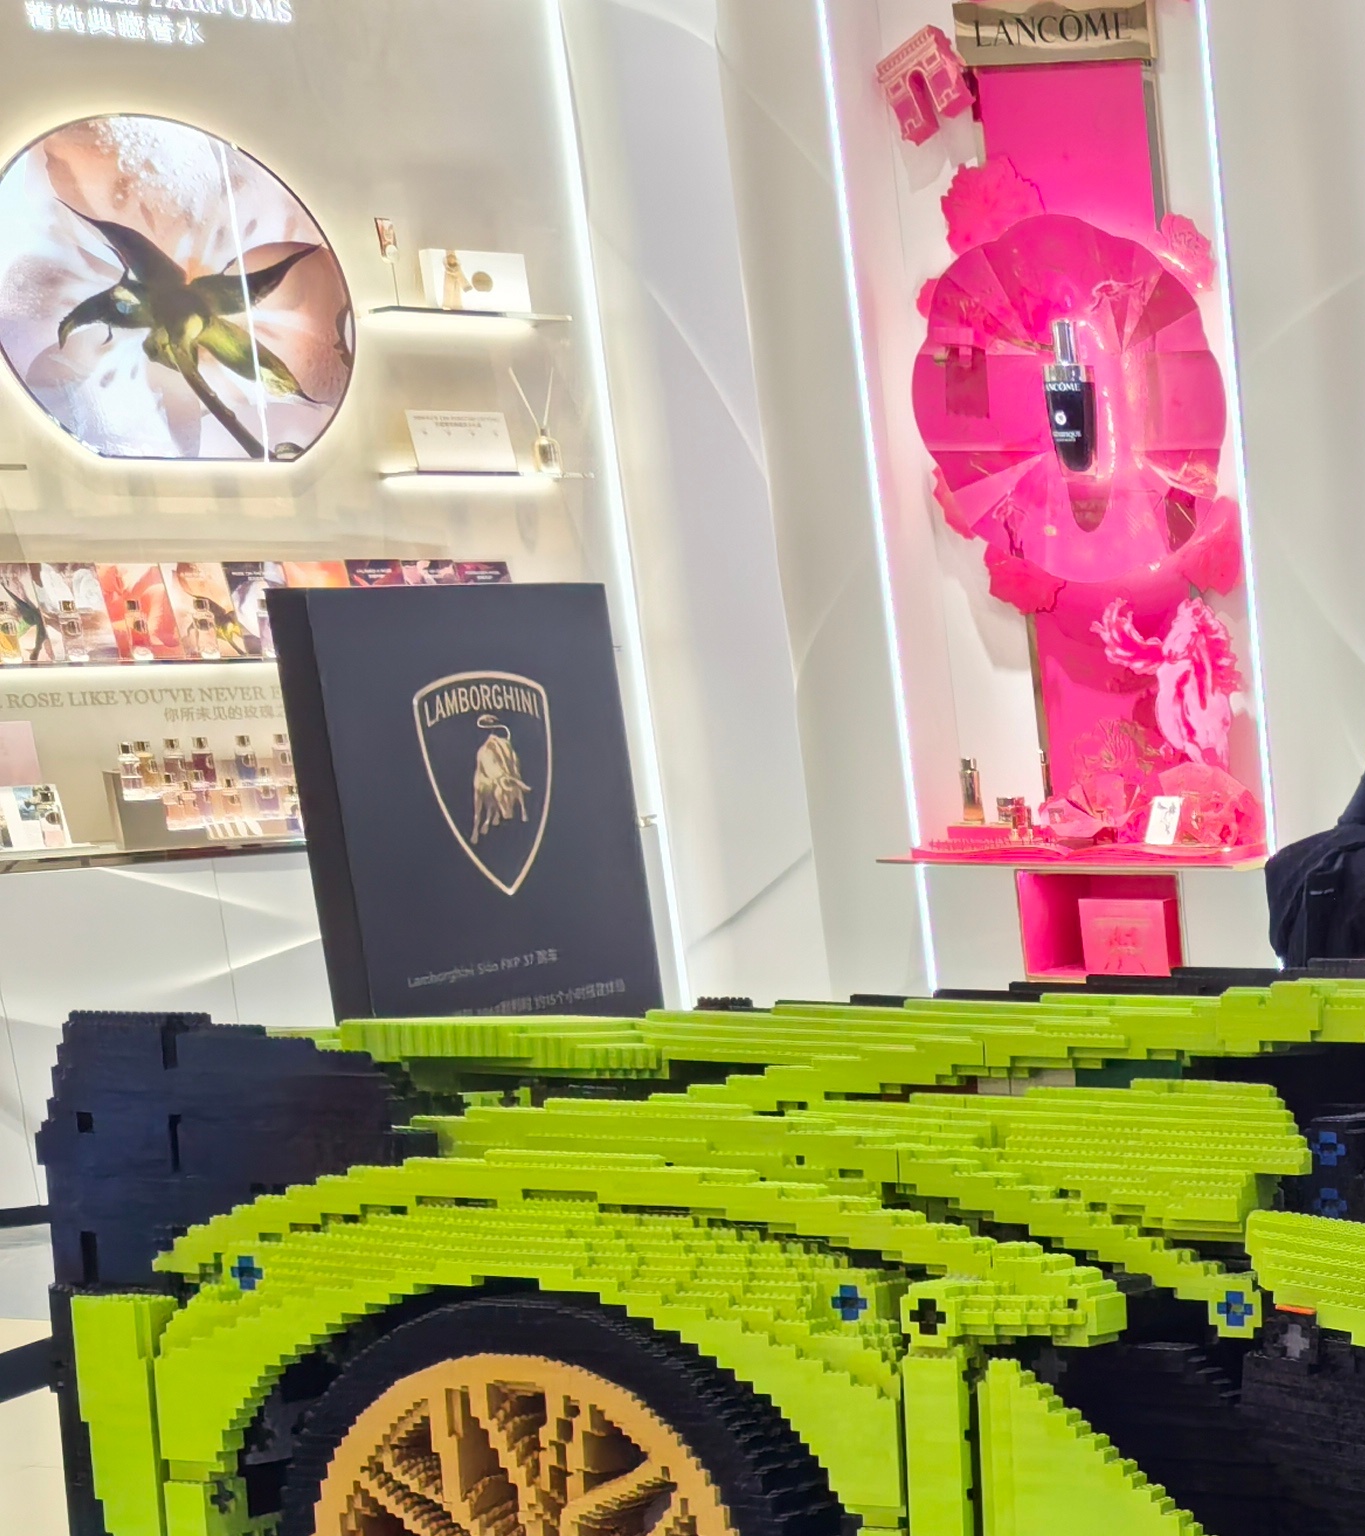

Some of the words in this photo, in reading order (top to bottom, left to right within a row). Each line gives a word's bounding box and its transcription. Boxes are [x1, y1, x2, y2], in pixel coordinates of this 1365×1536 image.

[6, 692, 64, 708] ROSE
[67, 689, 121, 707] LIKE
[120, 688, 195, 705] YOU'VE
[198, 686, 266, 702] NEVER
[424, 684, 541, 727] LAMBORGHINI
